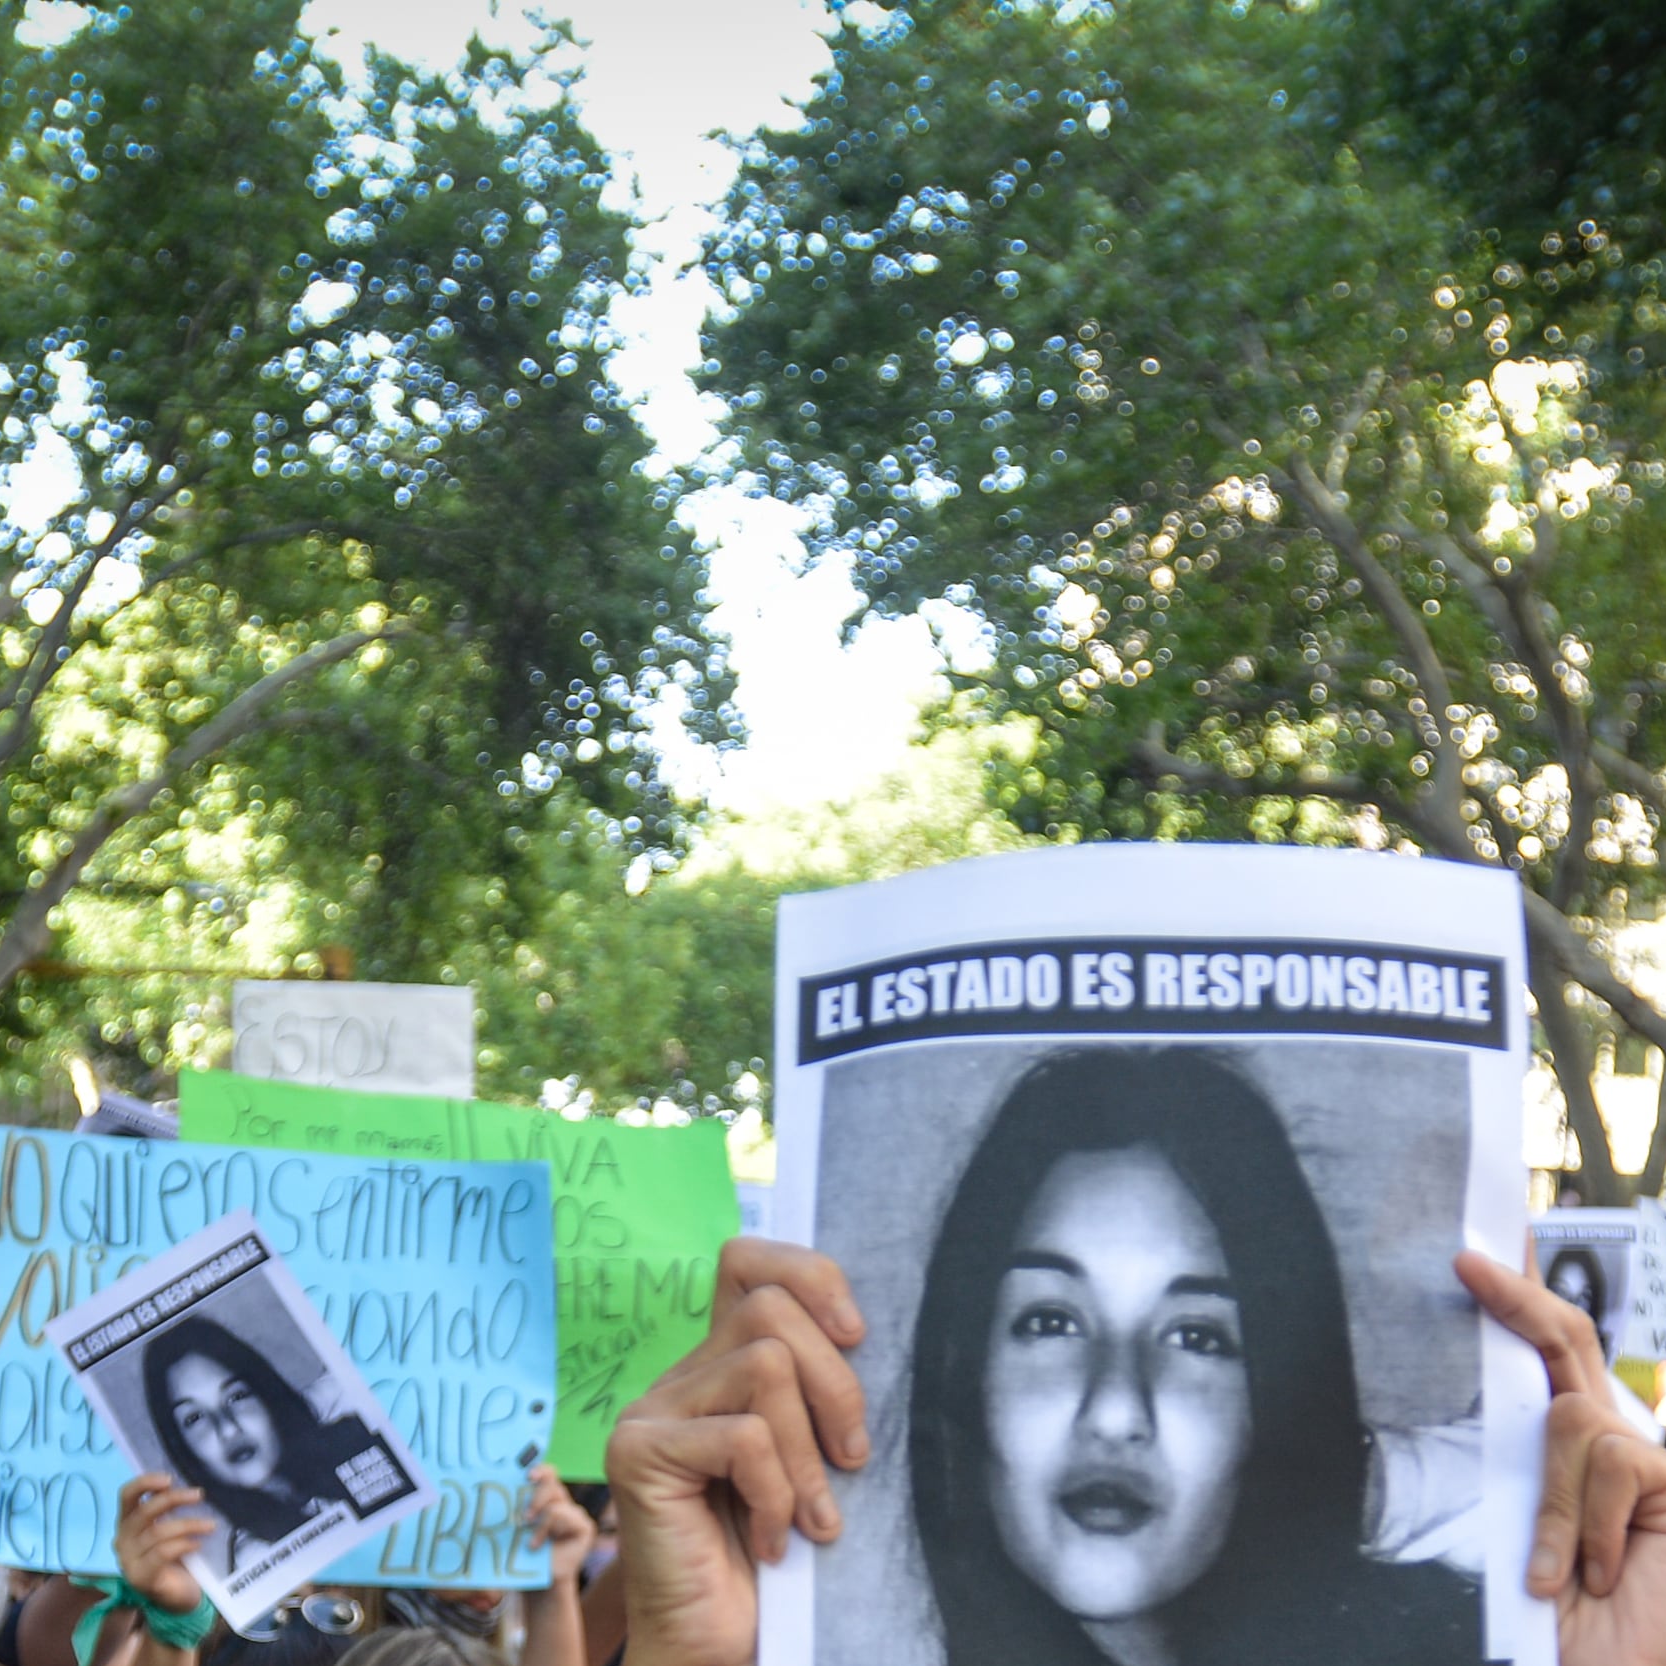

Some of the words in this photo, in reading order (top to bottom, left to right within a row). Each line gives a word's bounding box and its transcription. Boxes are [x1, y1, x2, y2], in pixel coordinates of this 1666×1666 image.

[817, 984, 865, 1038] EL
[870, 951, 1060, 1028] ESTADO
[1074, 951, 1136, 1007] ES
[1146, 951, 1493, 1027] RESPONSABLE
